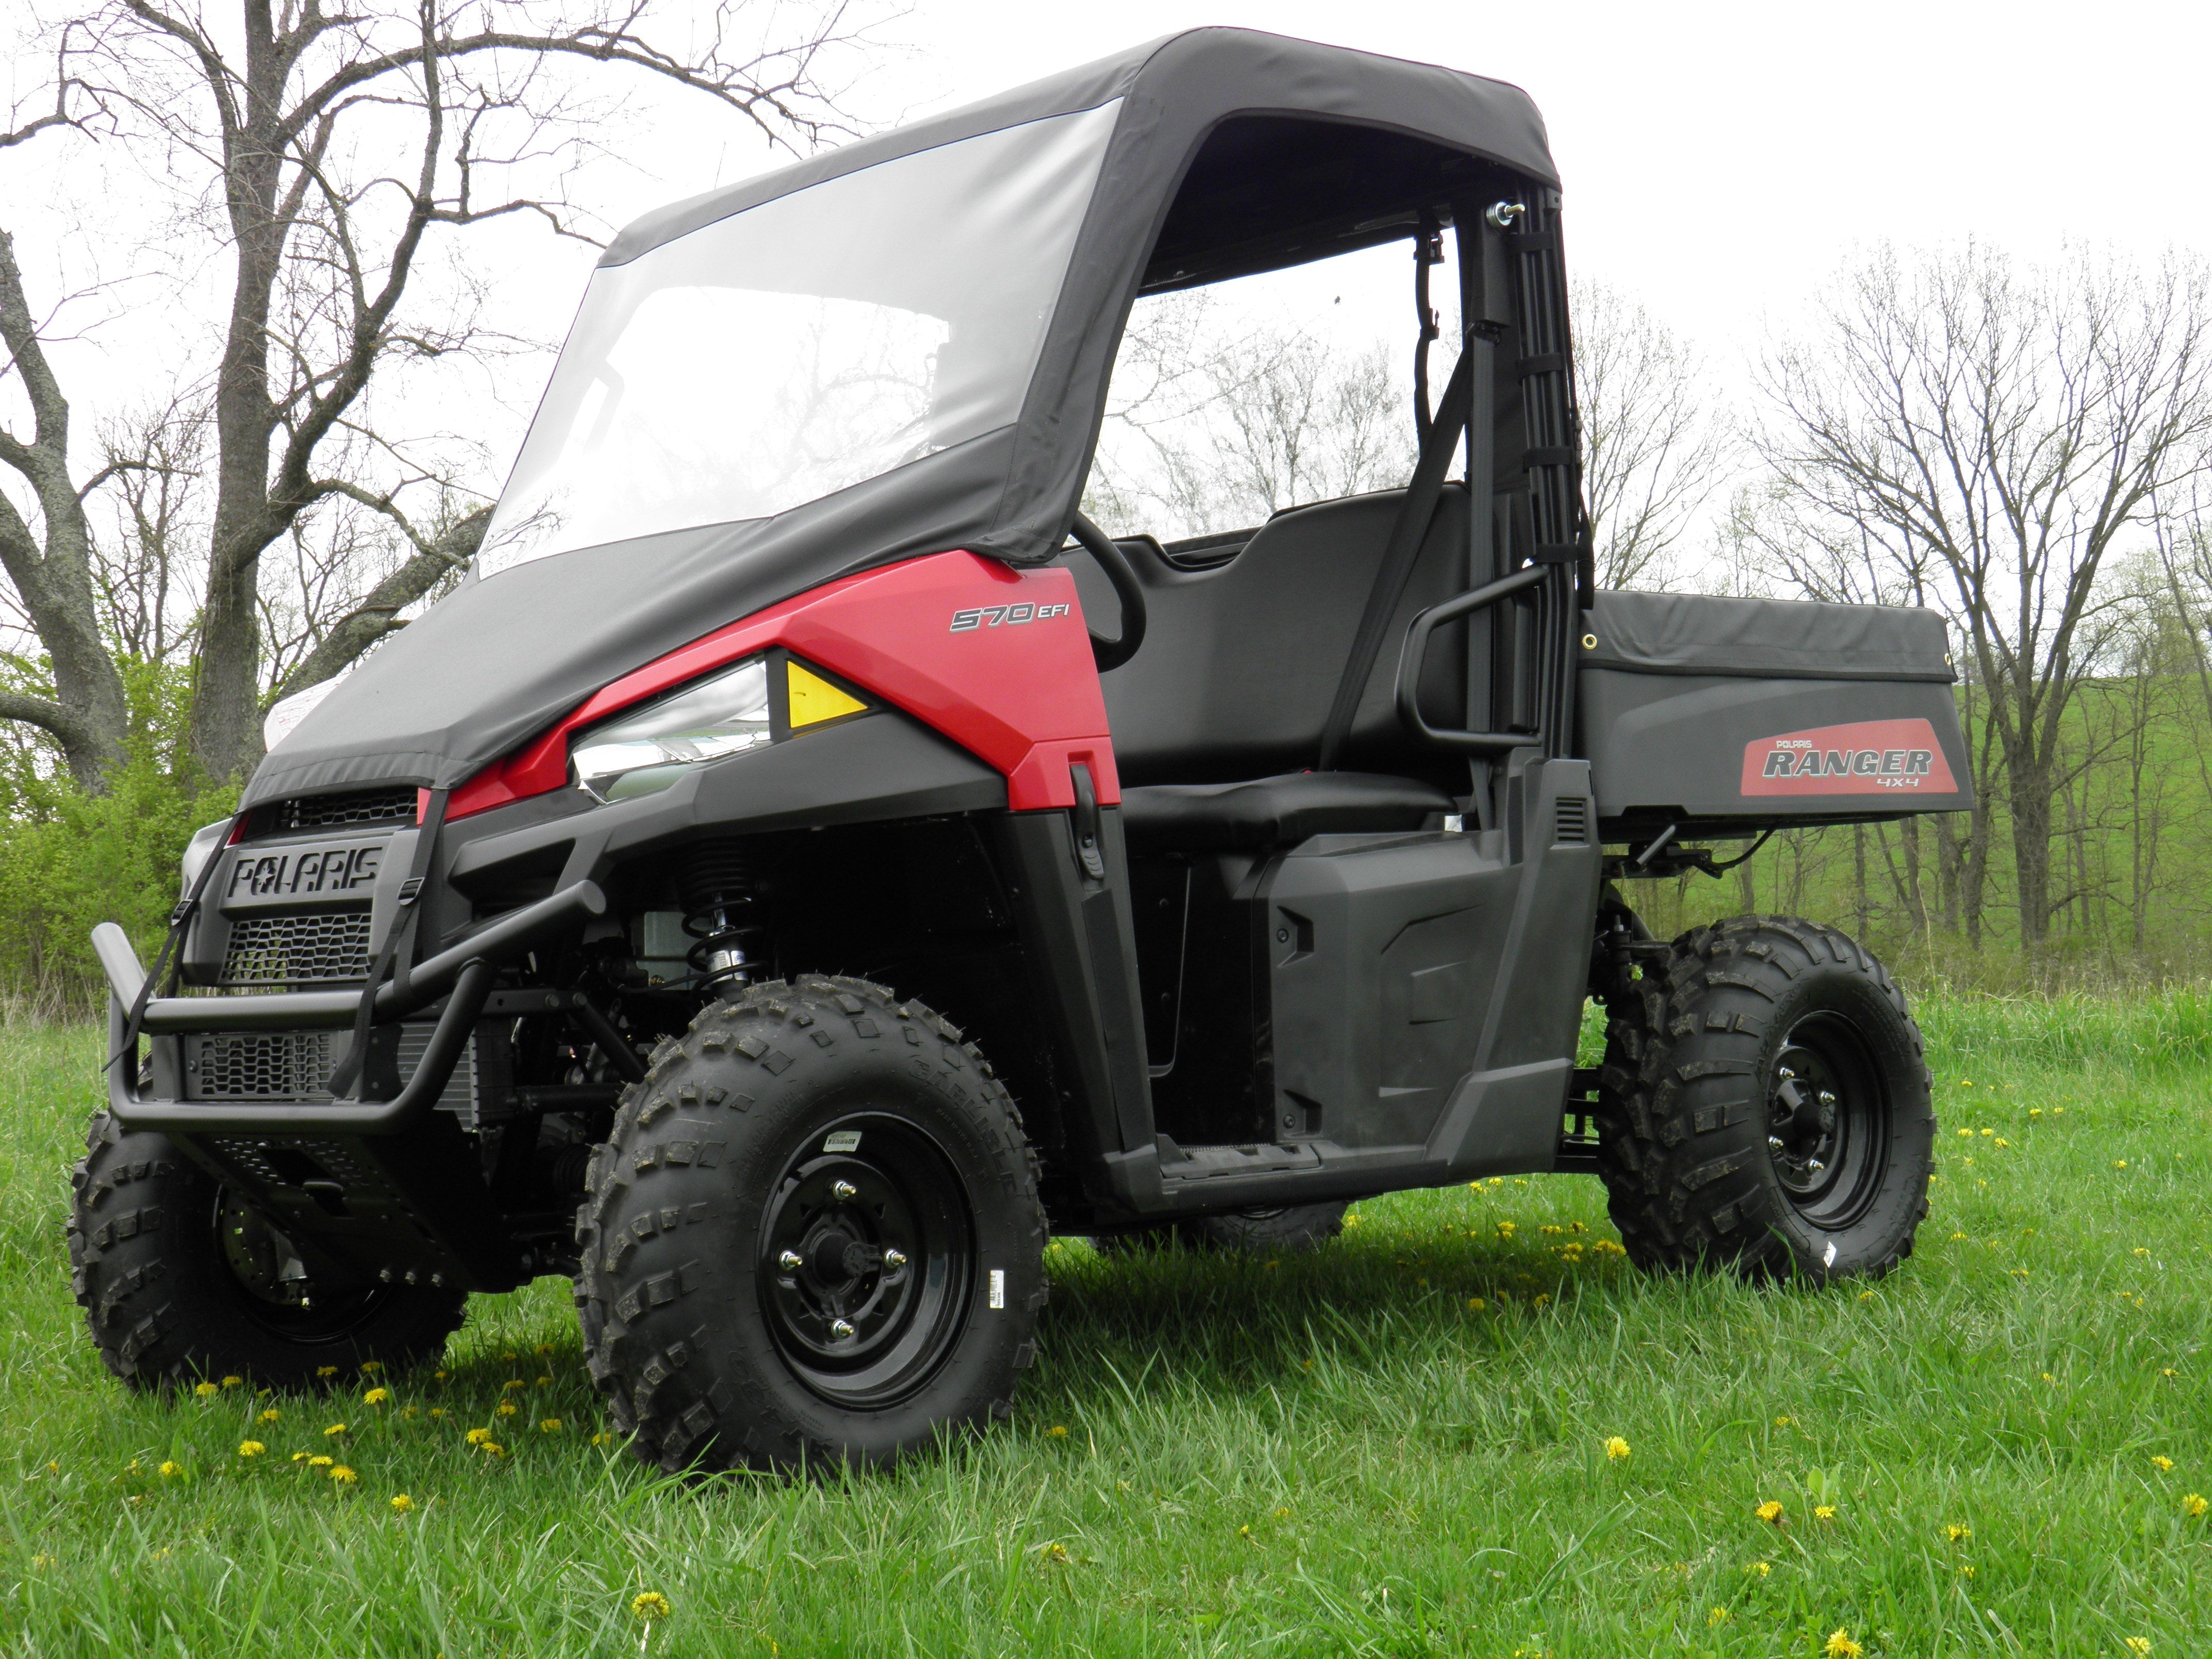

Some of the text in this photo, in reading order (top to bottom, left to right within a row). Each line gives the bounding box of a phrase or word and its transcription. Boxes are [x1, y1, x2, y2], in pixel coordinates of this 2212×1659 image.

[950, 602, 1070, 632] 570 EFI
[1776, 740, 1812, 749] POLARIS
[1762, 749, 1933, 778] RANGER
[1876, 778, 1920, 787] 4X4
[227, 847, 383, 898] POLARIS
[908, 1059, 1017, 1194] CARLISLE
